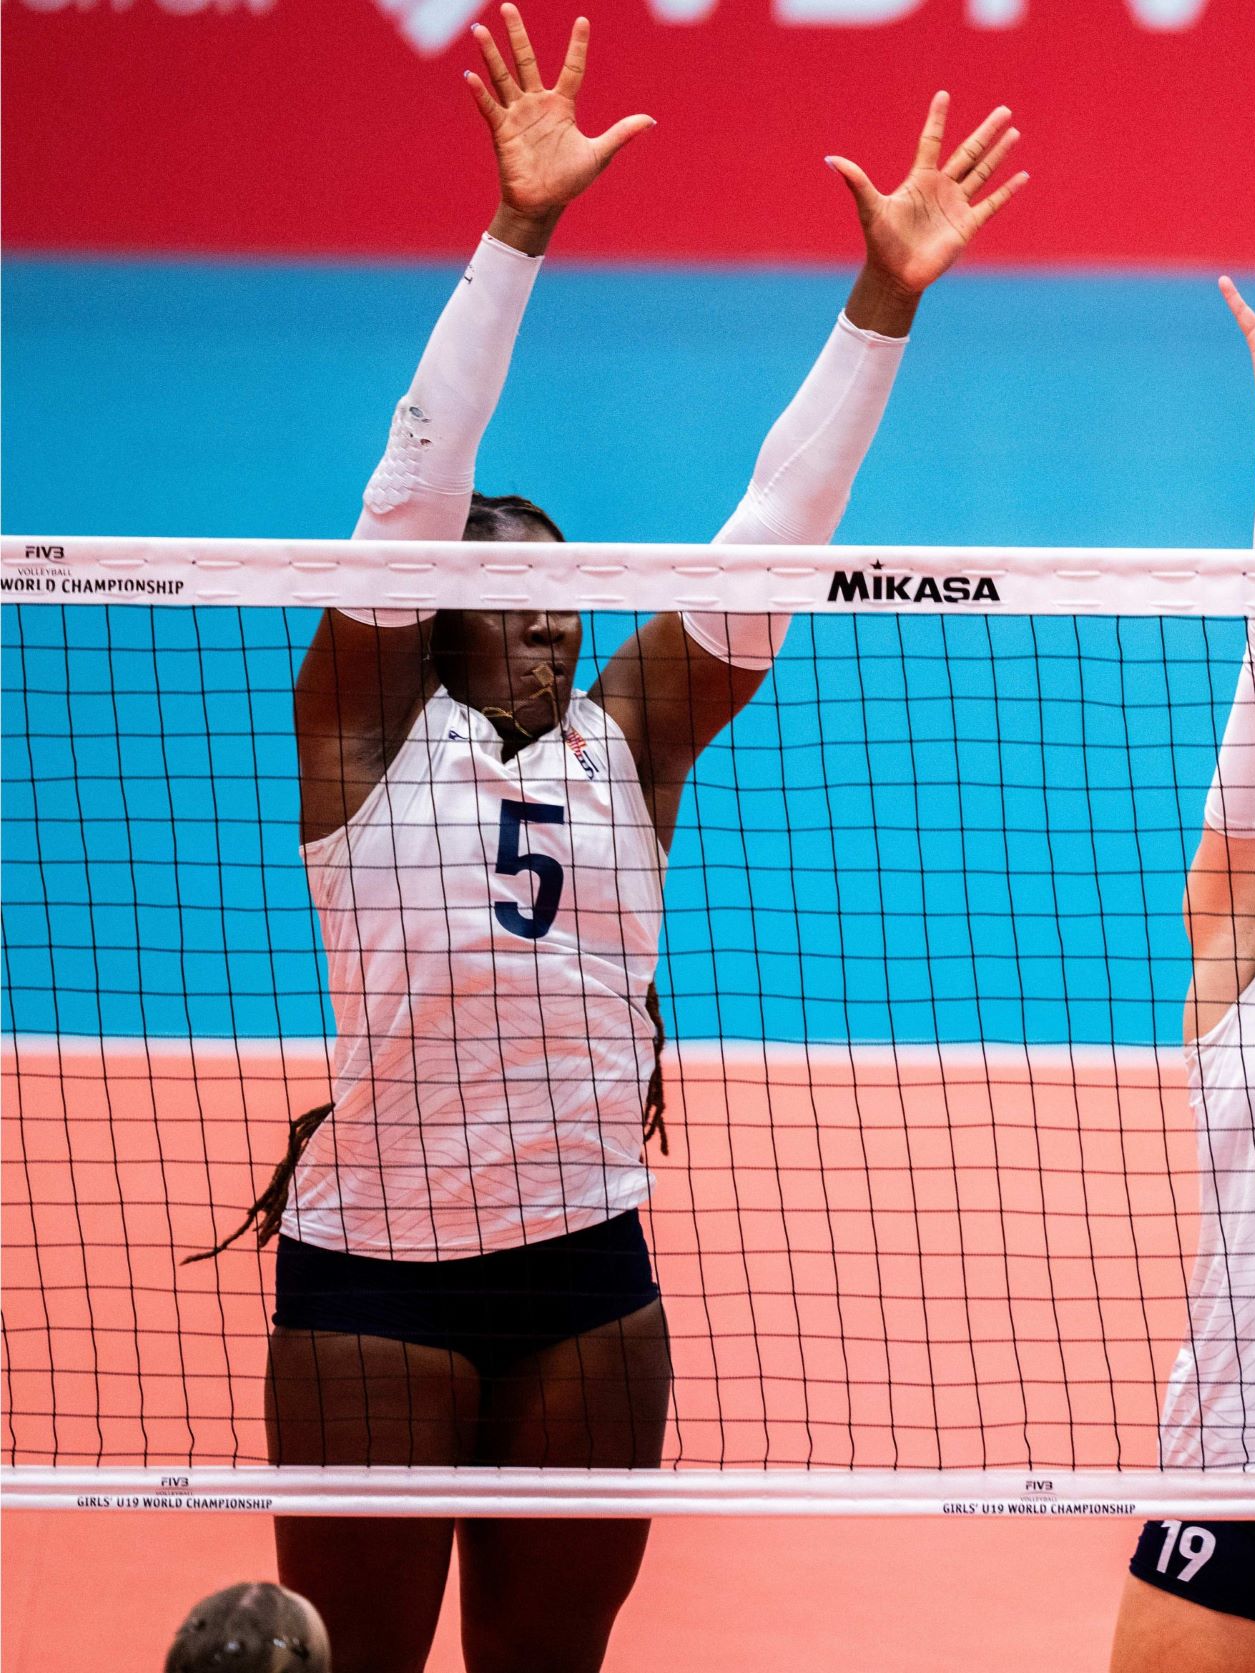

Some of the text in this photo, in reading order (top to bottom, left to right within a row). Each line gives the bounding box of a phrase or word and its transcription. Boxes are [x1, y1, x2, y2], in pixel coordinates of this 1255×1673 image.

[1, 578, 185, 595] WORLD CHAMPIONSHIP
[494, 799, 564, 939] 5
[77, 1496, 273, 1510] GIRLS' U19 WORLD CHAMPIONSHIP
[943, 1503, 1136, 1514] GIRLS' U19 WORLD CHAMPIONSHIP
[1155, 1520, 1217, 1583] 19
